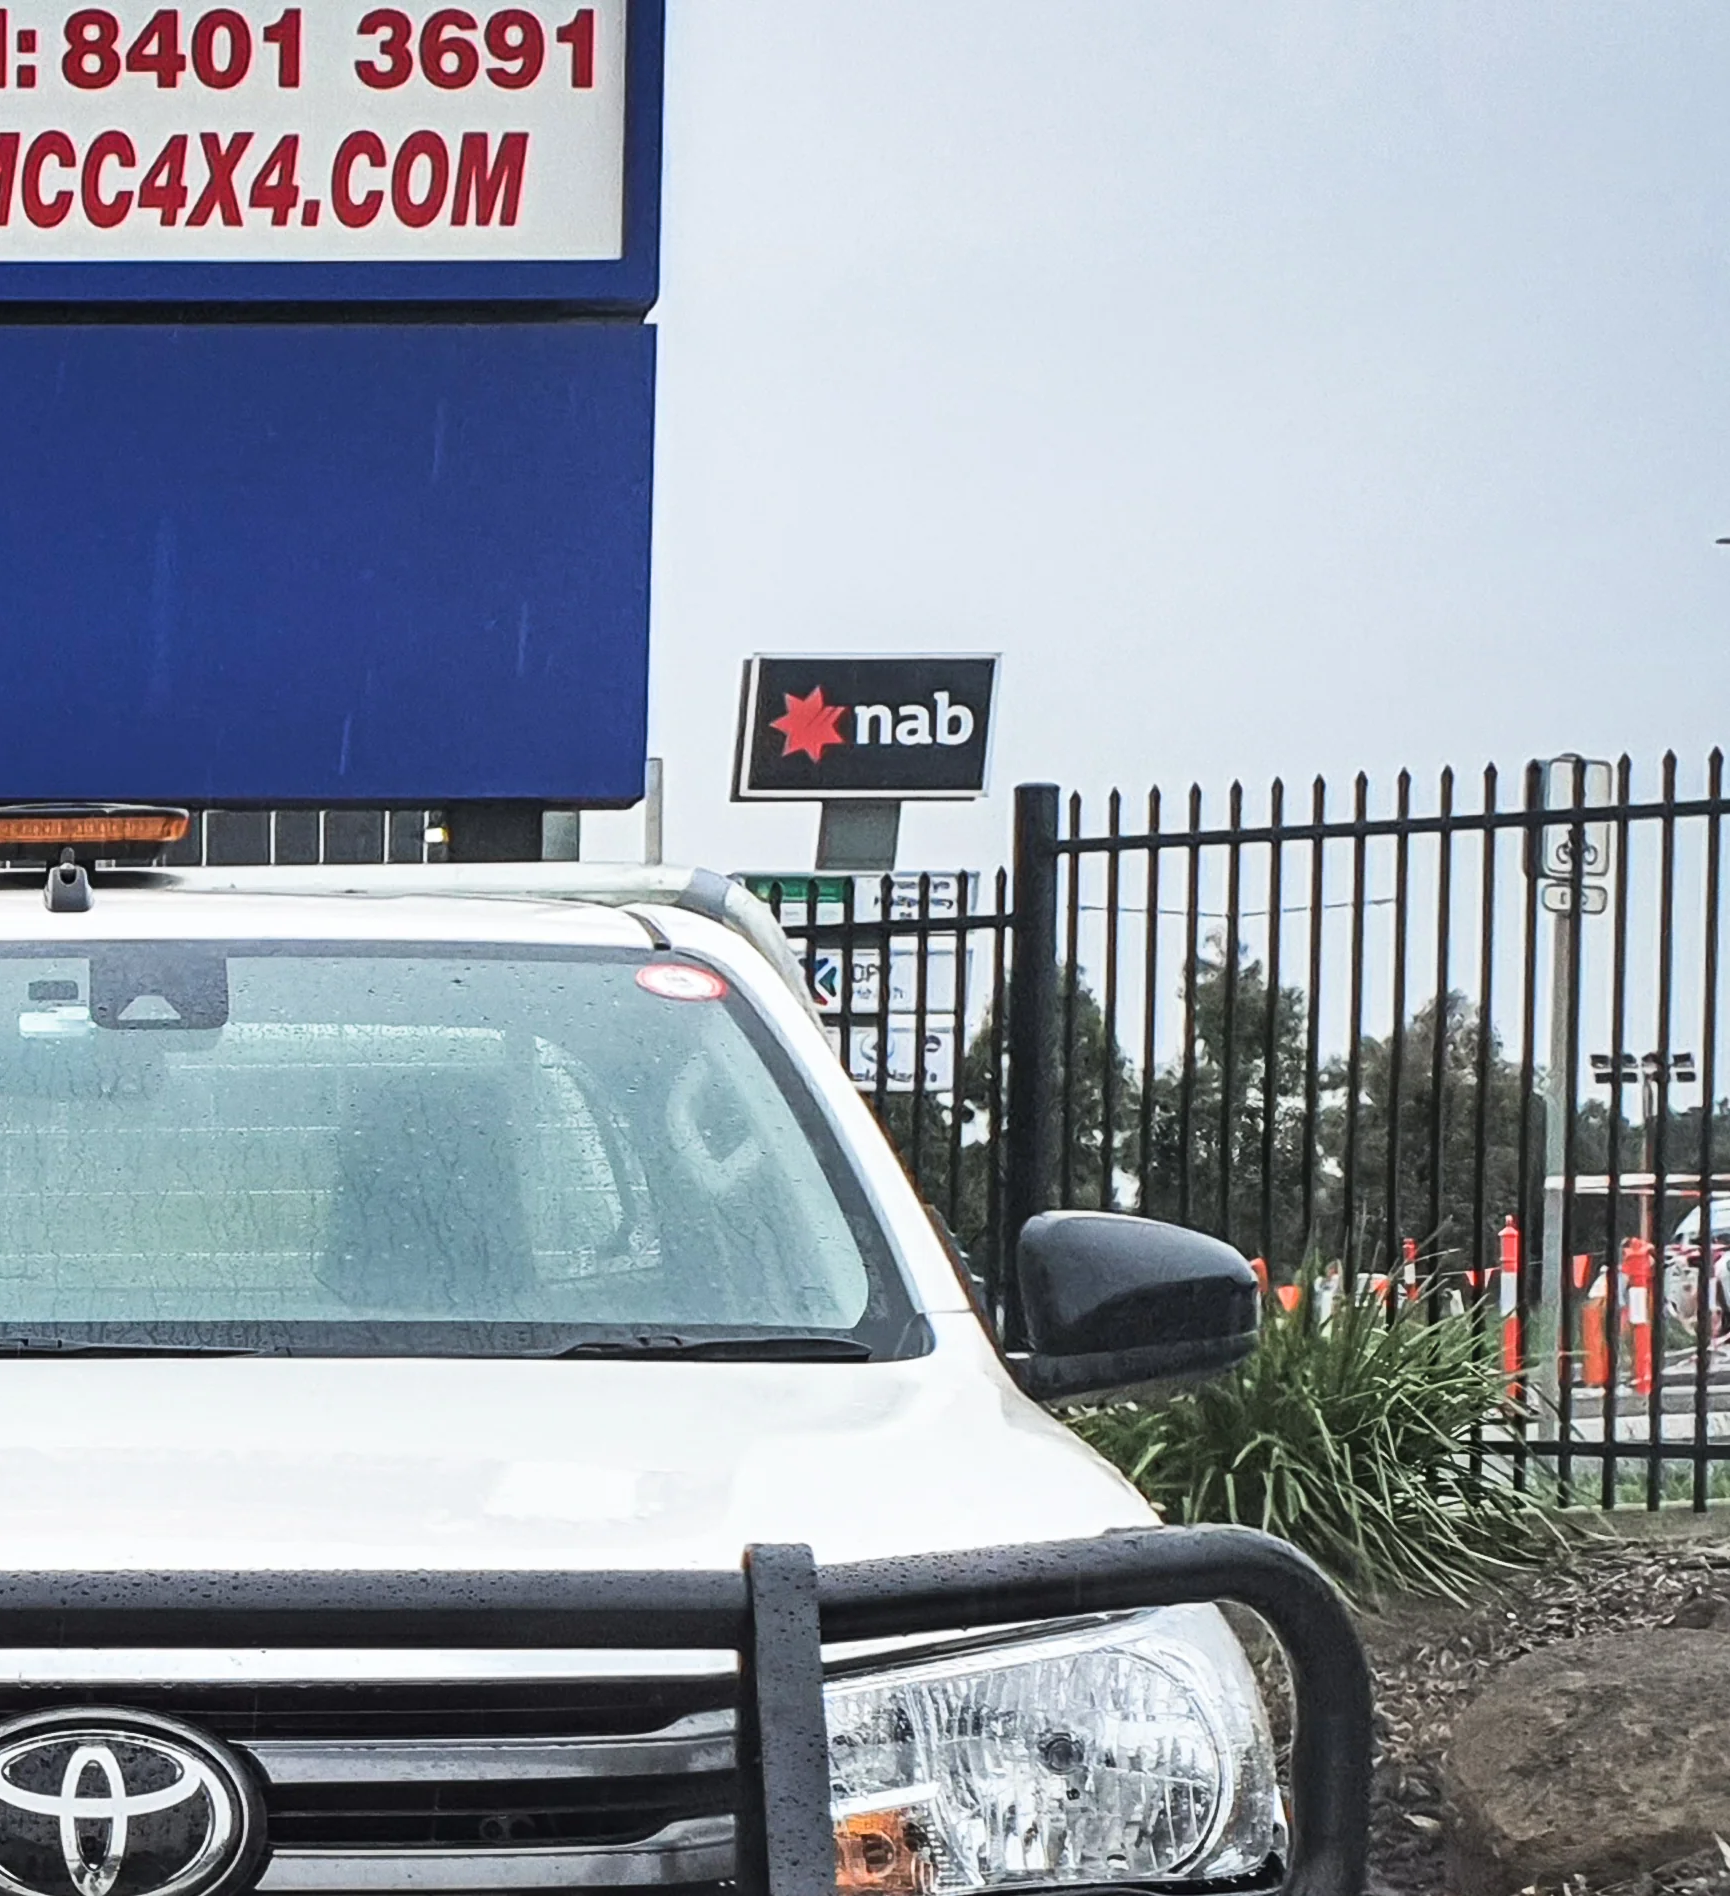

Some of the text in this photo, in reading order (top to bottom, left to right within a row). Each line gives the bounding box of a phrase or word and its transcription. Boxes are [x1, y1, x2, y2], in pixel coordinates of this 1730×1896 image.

[62, 9, 304, 91] 8401
[355, 9, 597, 91] 3691
[855, 691, 974, 745] nab
